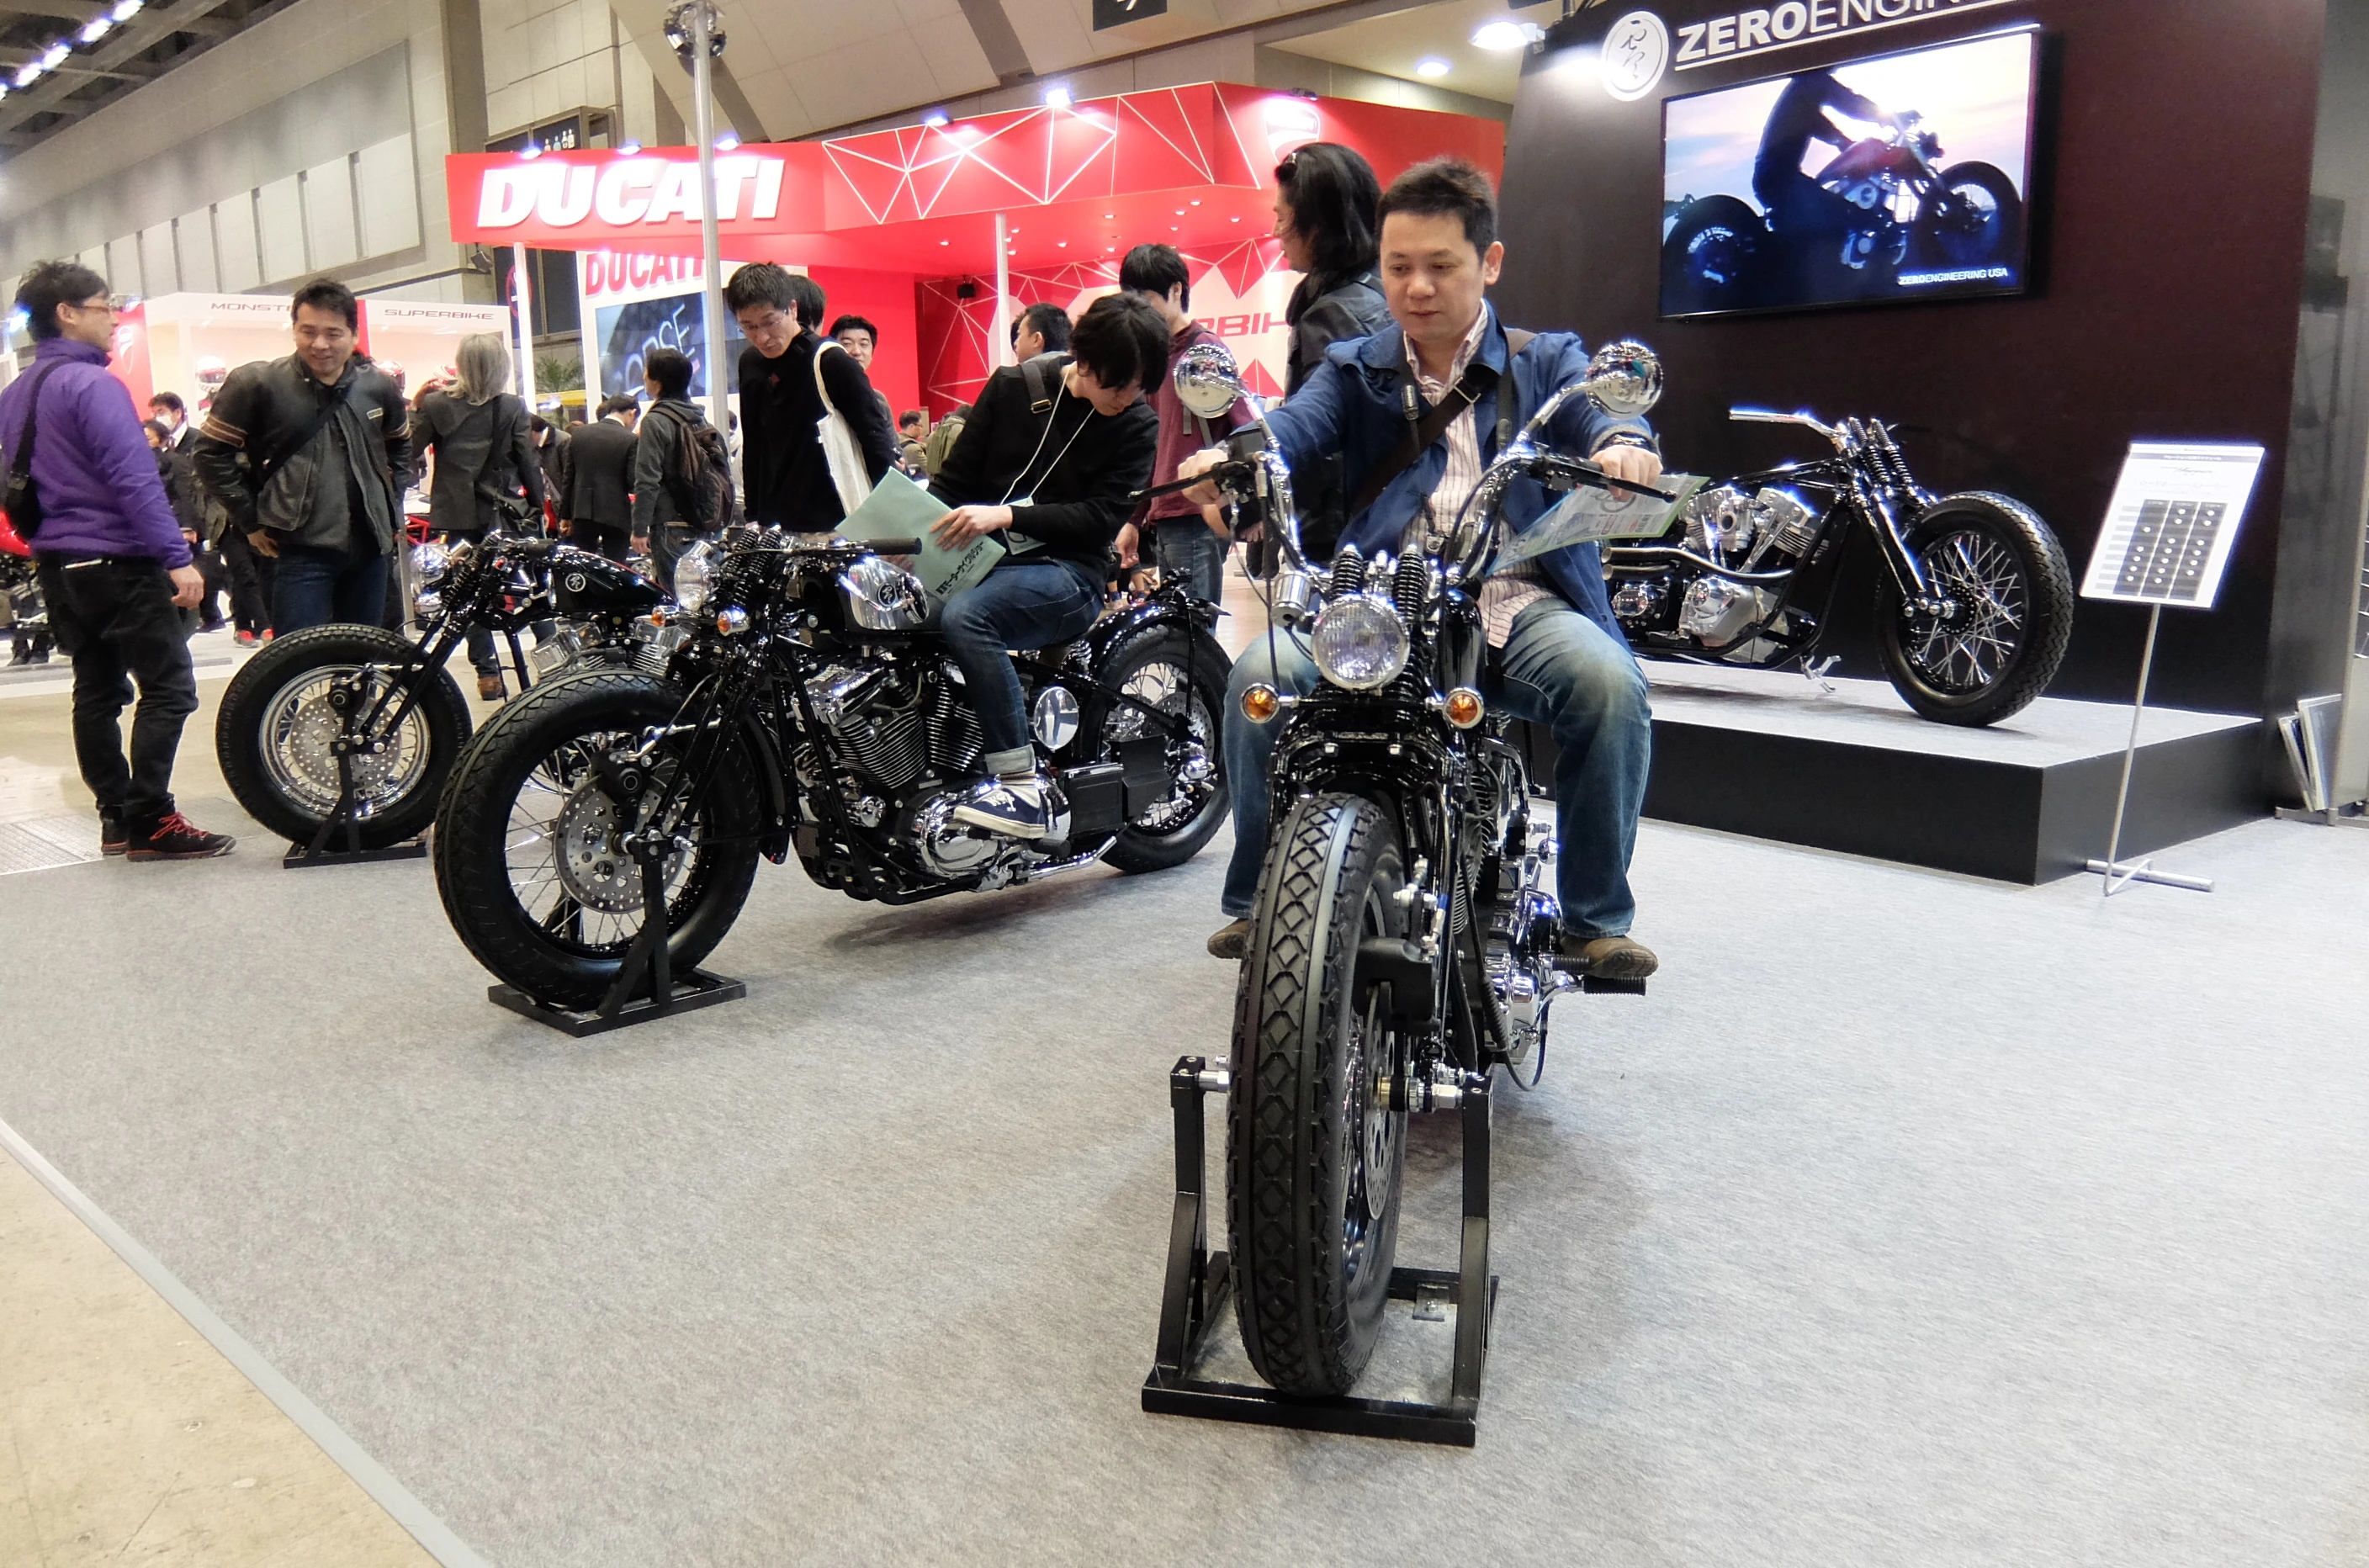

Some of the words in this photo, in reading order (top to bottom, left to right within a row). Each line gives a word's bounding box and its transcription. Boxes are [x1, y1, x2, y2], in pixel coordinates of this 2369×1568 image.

[1676, 0, 1960, 62] ZEROEN
[477, 158, 784, 228] DUCATI
[1988, 267, 2008, 278] USA
[384, 309, 494, 320] SUPERBIKE
